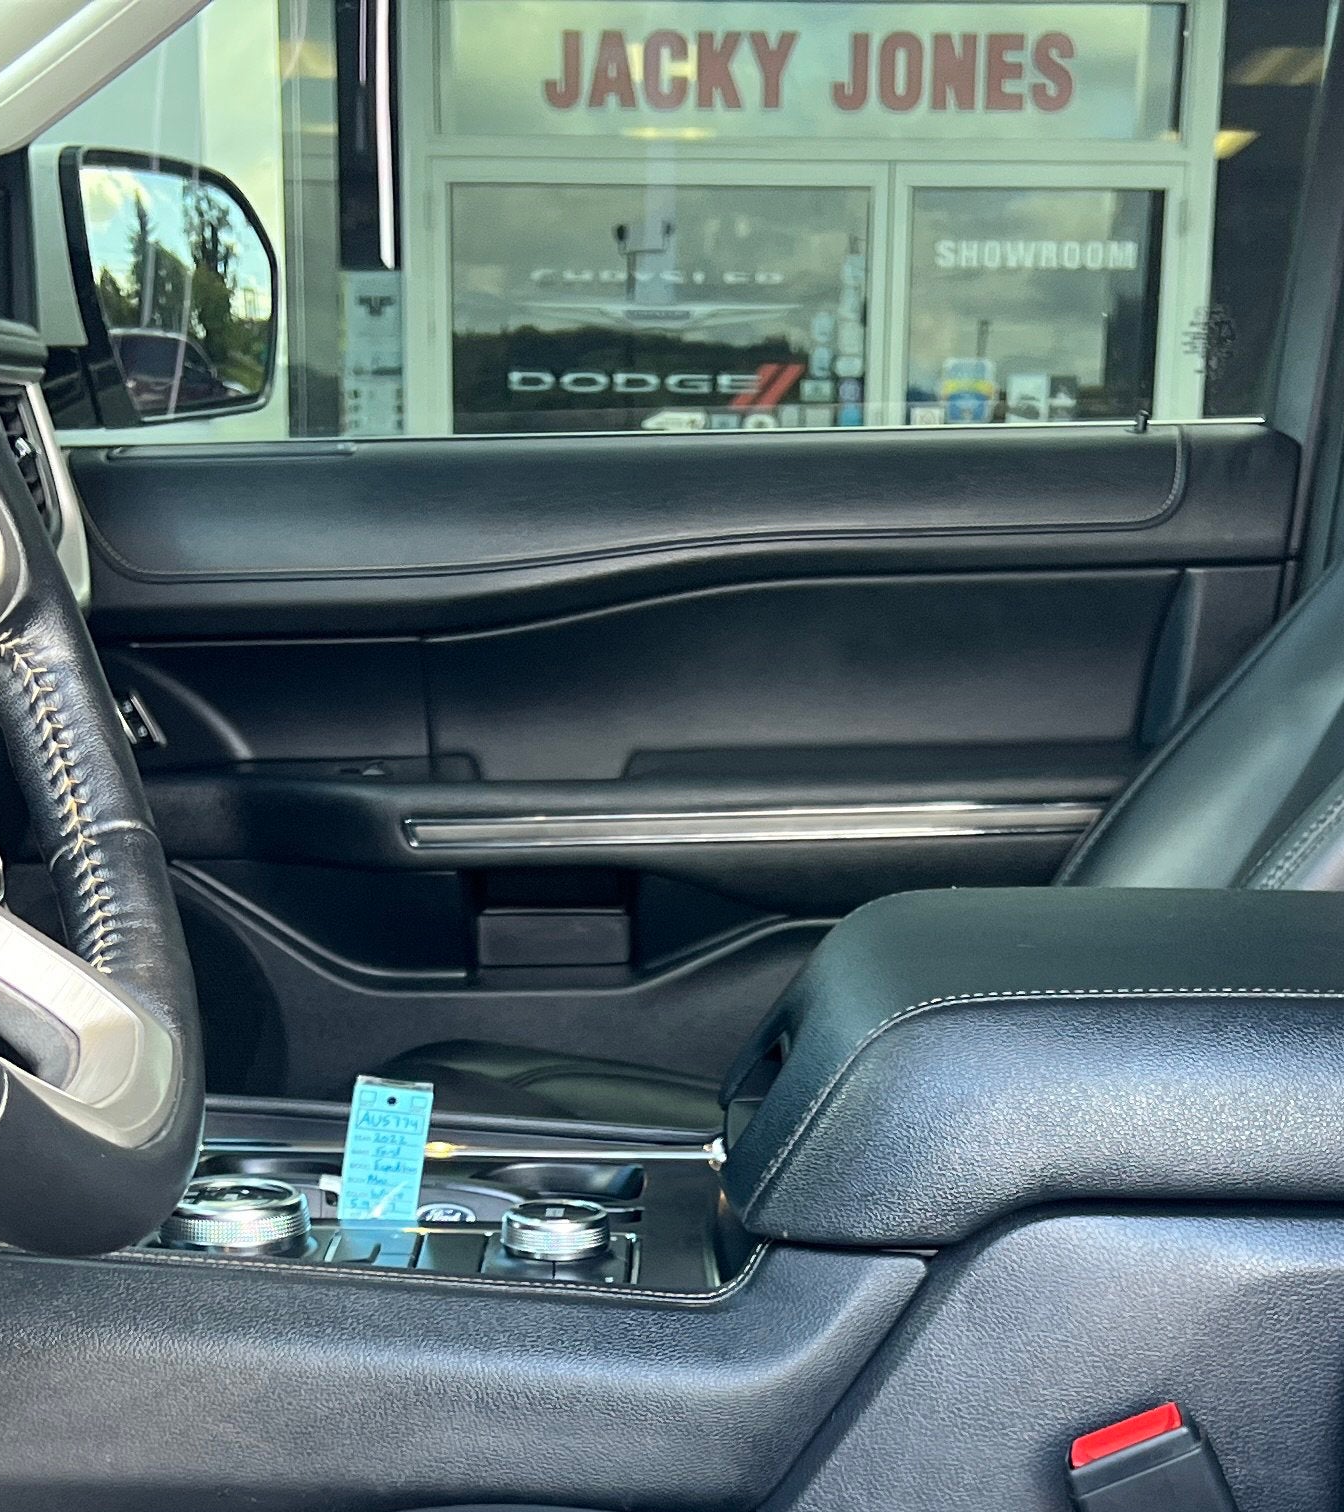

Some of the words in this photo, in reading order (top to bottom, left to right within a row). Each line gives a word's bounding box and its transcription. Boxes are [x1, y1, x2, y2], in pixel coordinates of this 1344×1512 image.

[544, 30, 799, 109] JACKY
[830, 31, 1075, 111] JONES
[935, 240, 1138, 269] SHOWROOM
[507, 371, 764, 394] DODGE
